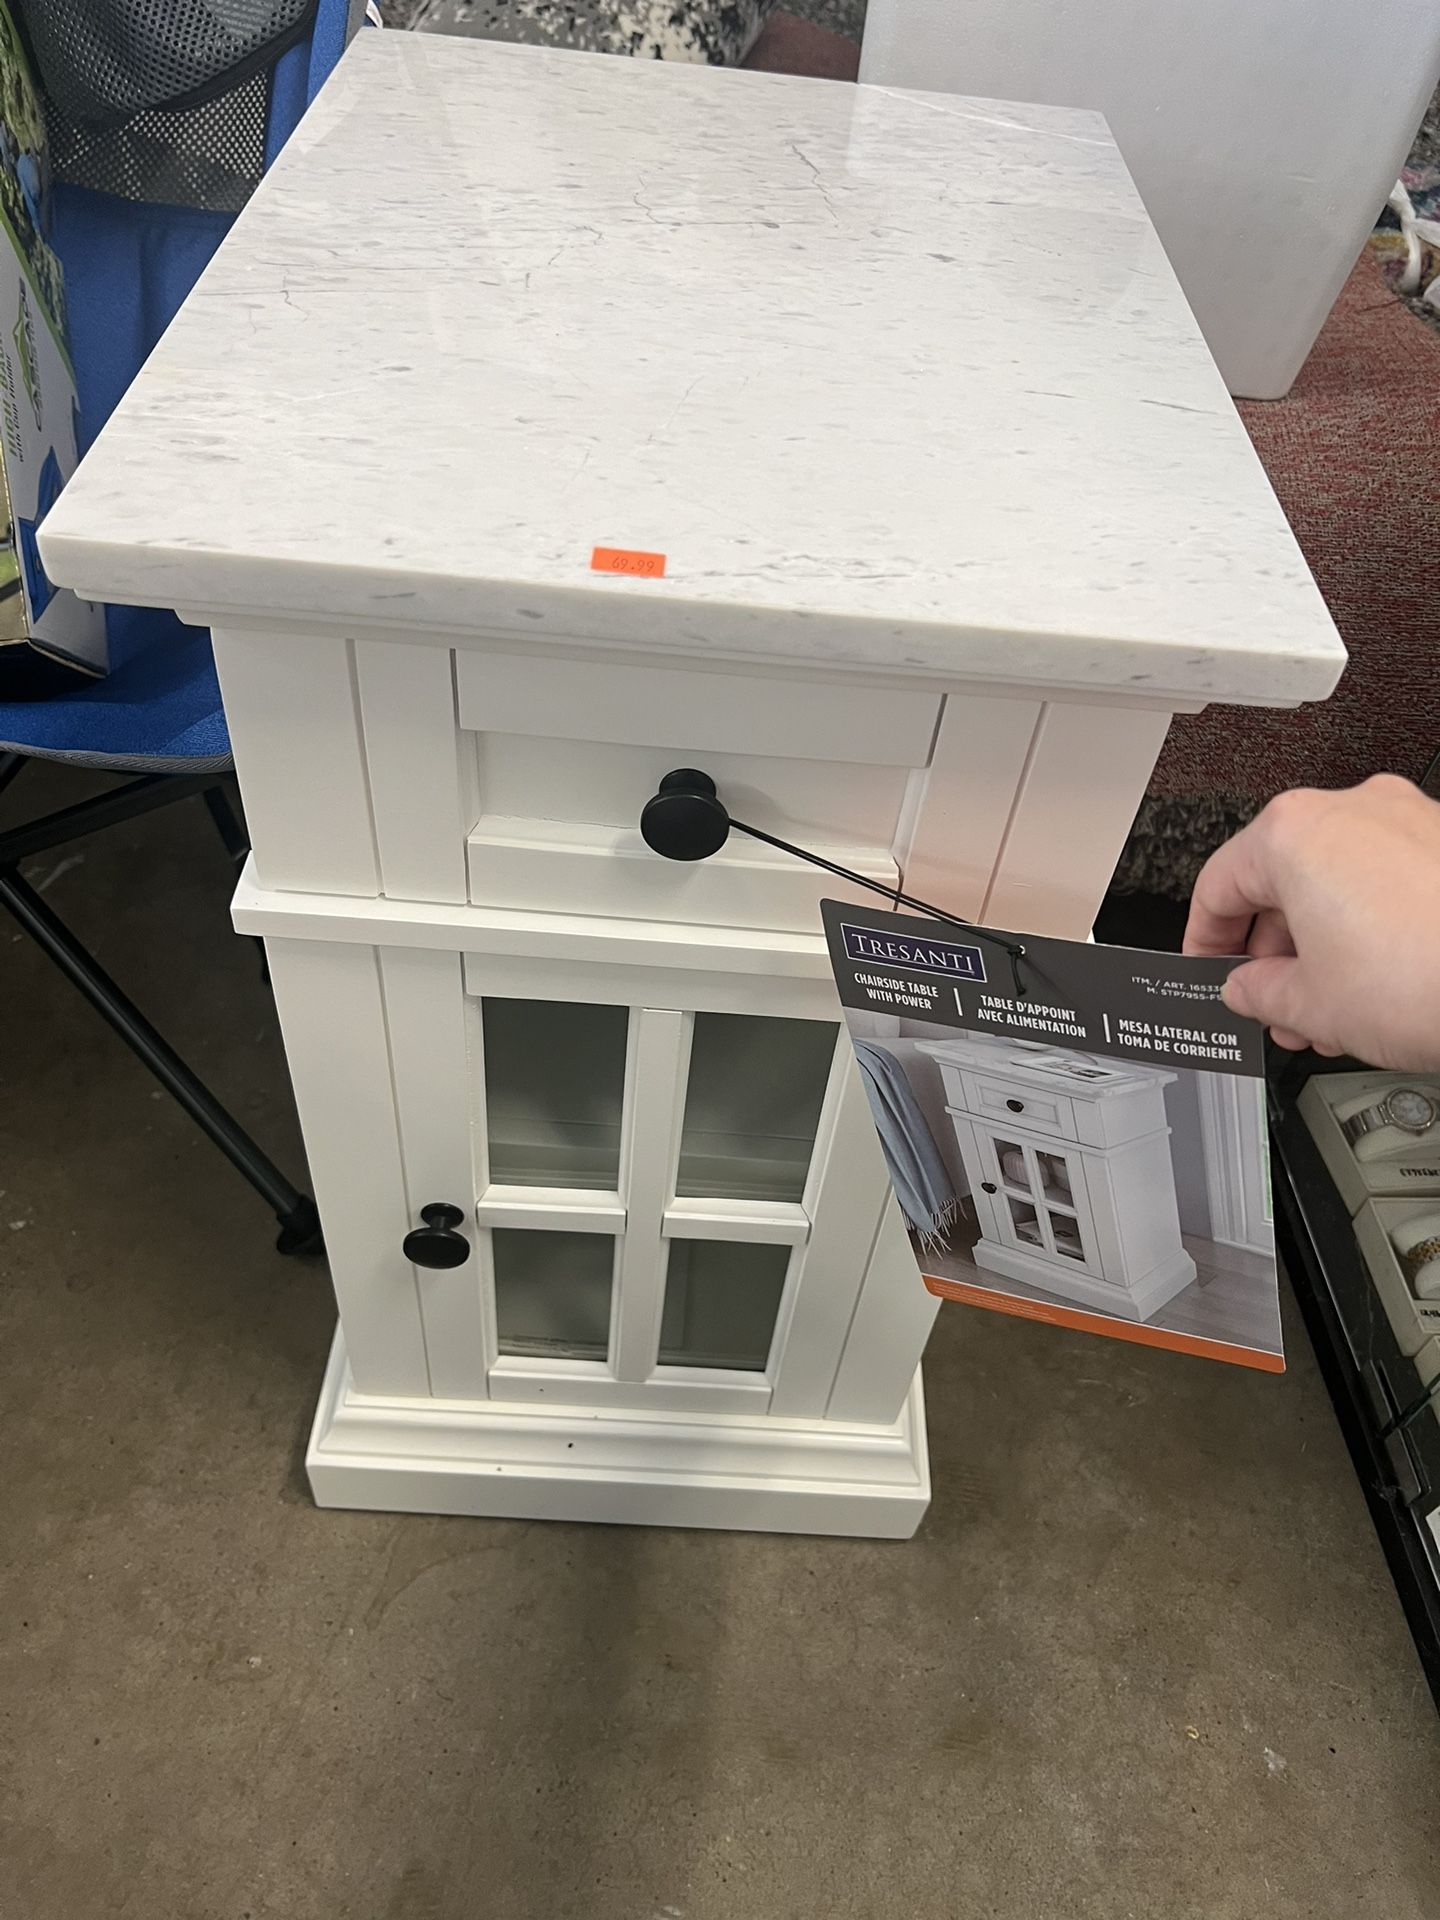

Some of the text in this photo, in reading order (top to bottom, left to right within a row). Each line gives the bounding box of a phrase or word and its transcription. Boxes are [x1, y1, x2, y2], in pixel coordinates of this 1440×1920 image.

[6, 353, 16, 399] Holder
[12, 403, 20, 429] Cup
[611, 555, 655, 572] 69.99
[851, 933, 975, 971] TRESANTI
[854, 972, 939, 998] CHAIRSIDE TABLE
[1131, 976, 1220, 993] ITM. / ART. 16533
[866, 988, 932, 1010] WITH POWER
[980, 994, 1076, 1022] TABLE D'APPOINT
[977, 1008, 1087, 1038] AVEC ALIMENTATION
[1119, 1018, 1238, 1046] MESA LATERAL CON
[1117, 1033, 1243, 1061] TOMA DE CORRIENTE
